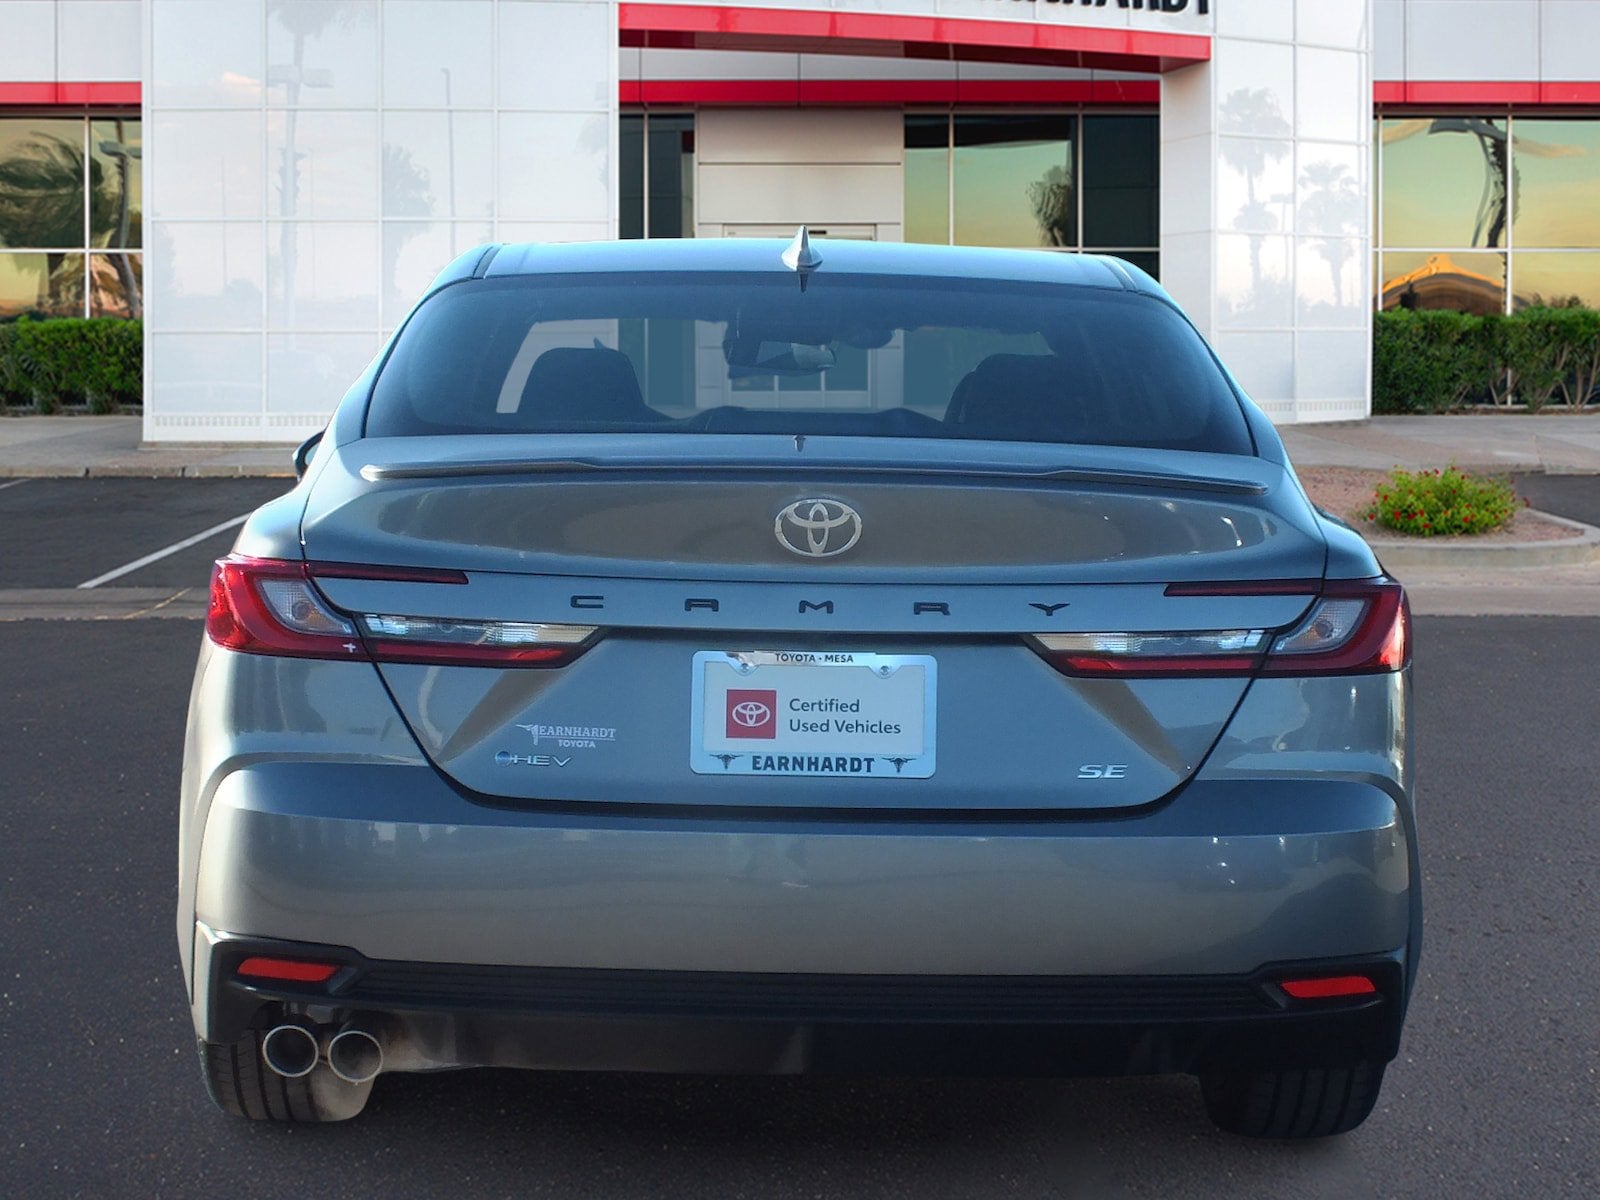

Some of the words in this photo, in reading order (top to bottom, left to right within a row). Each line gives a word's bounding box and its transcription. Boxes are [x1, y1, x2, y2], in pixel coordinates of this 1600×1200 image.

[570, 595, 1071, 616] CAMRY
[775, 653, 816, 663] TOYOTA
[824, 655, 854, 663] MESA
[789, 698, 860, 713] Certified
[538, 726, 616, 738] EARNHARDT
[789, 719, 830, 733] Used
[834, 720, 901, 734] Vehicles
[558, 740, 596, 748] TOYOTA
[752, 755, 875, 773] EARNHARDT
[1077, 764, 1128, 779] SE
